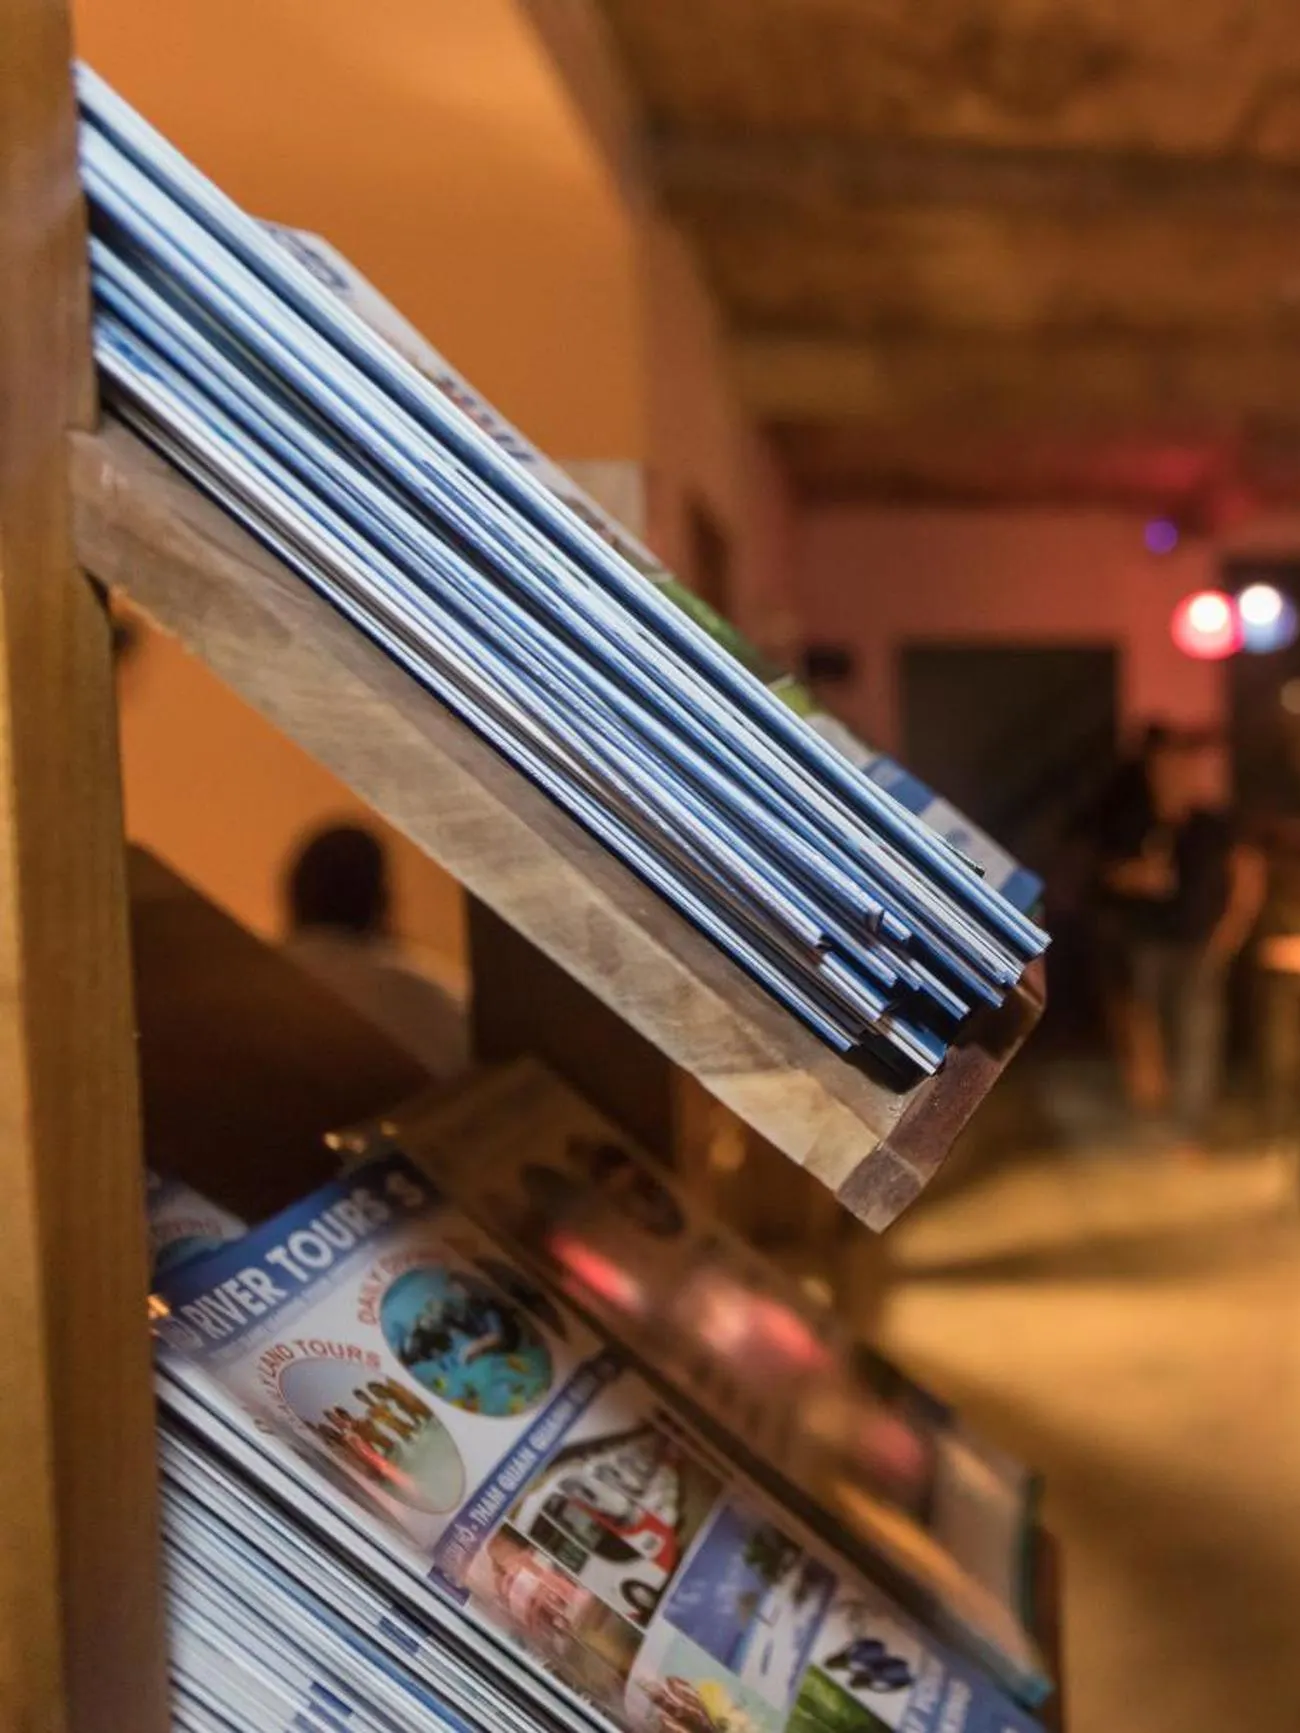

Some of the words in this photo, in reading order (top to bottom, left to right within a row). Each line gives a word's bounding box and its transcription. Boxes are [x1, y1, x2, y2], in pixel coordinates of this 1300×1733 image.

[180, 1267, 287, 1341] RIVER
[264, 1188, 391, 1283] TOURS
[293, 1338, 381, 1370] TOURS
